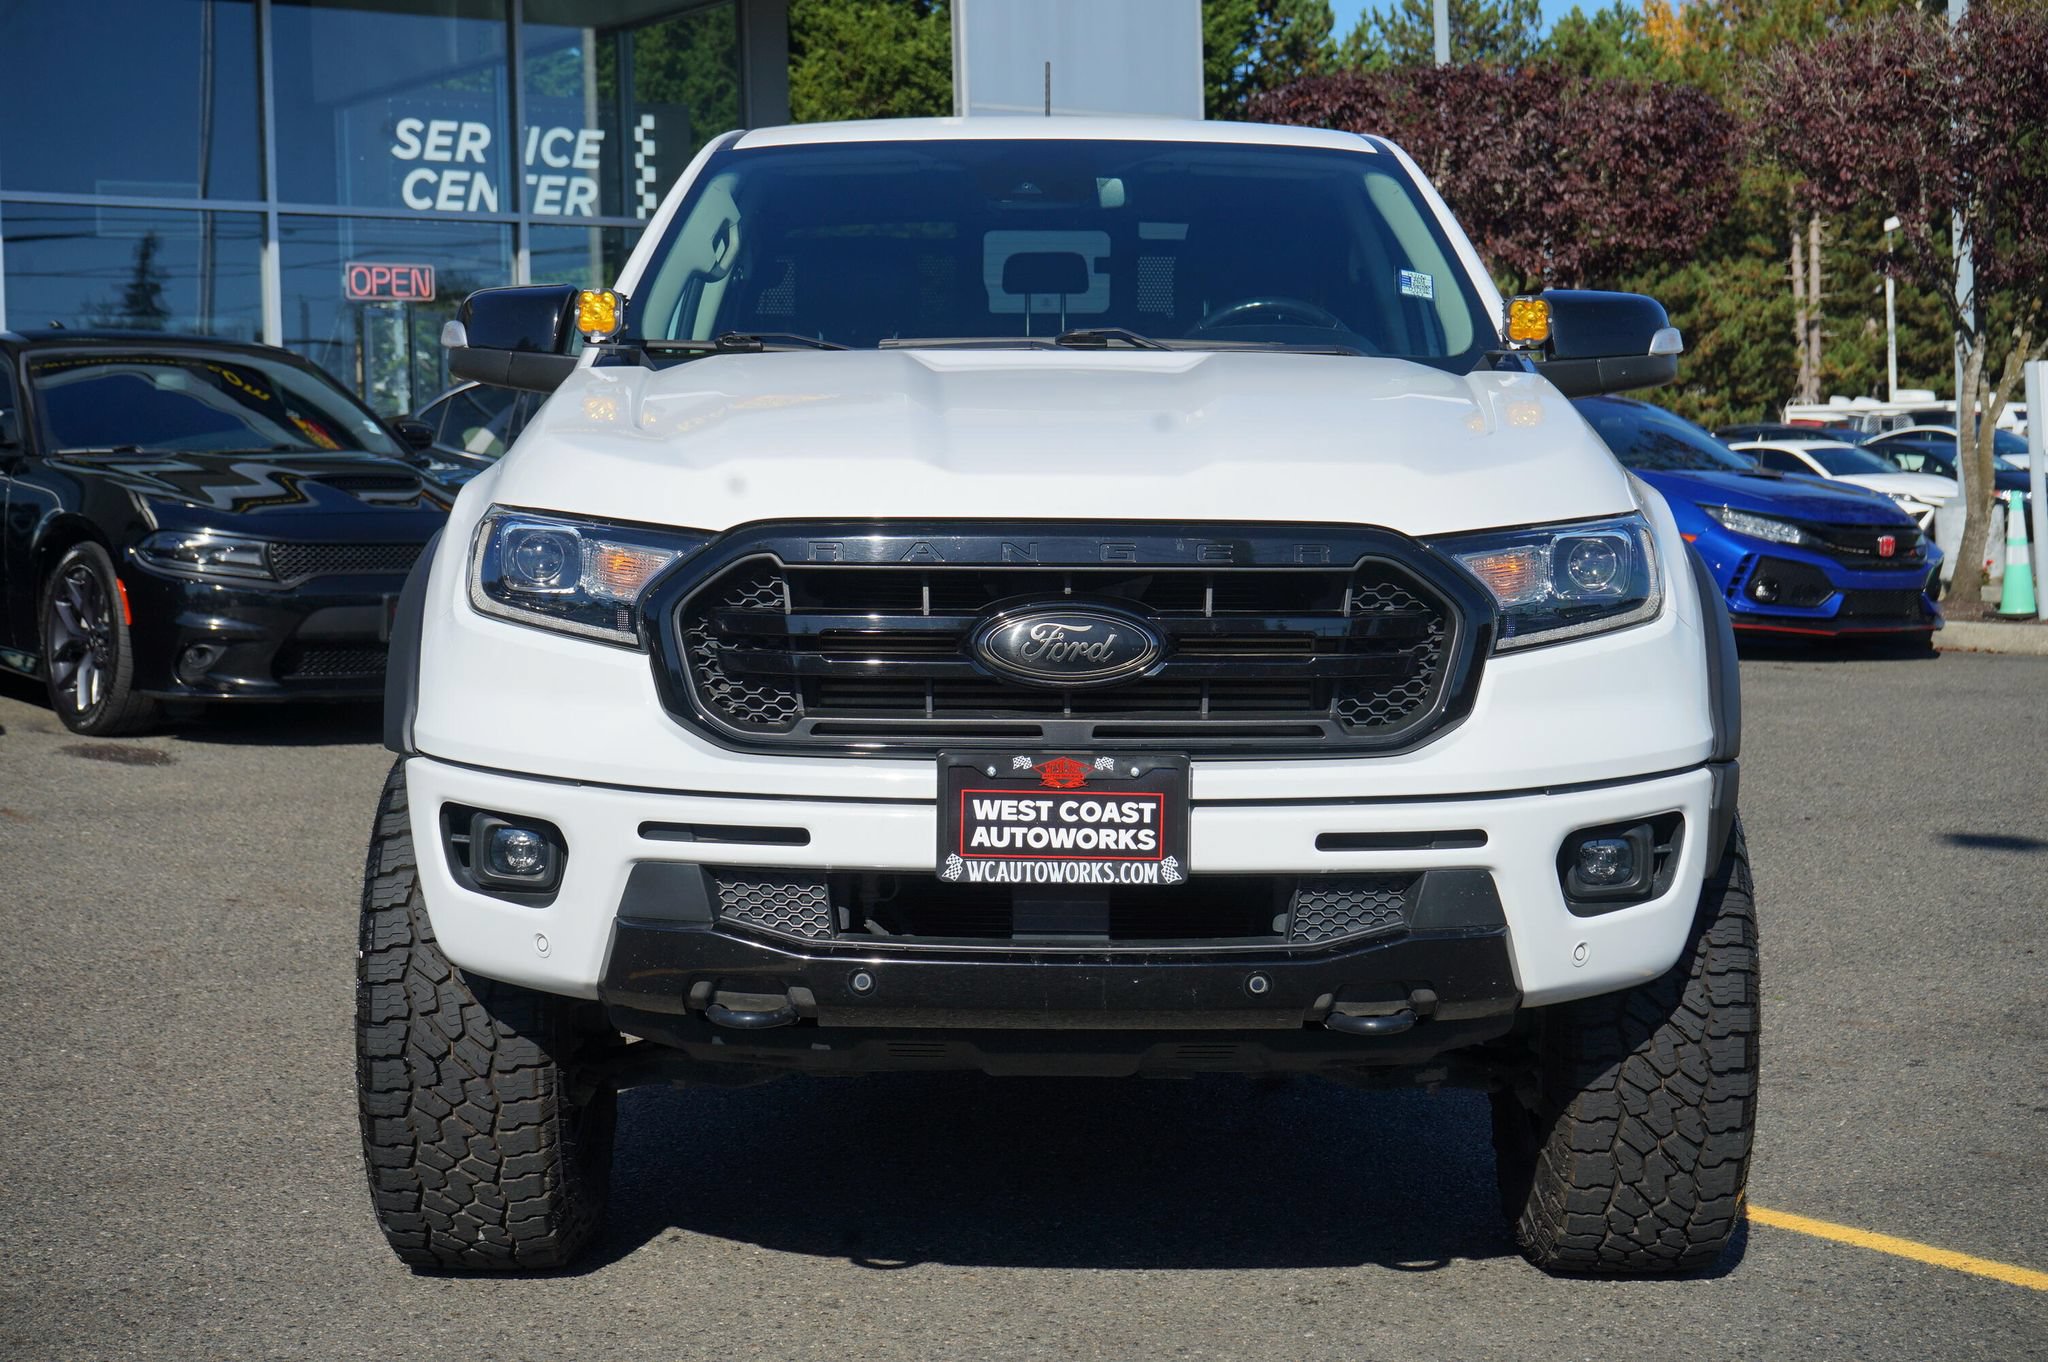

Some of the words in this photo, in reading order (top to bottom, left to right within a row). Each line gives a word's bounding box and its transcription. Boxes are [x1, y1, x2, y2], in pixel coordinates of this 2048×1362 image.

[391, 118, 605, 169] SERICE
[350, 266, 431, 297] OPEN
[808, 541, 1331, 563] RANGER
[1020, 622, 1118, 663] Ford
[972, 799, 1053, 822] WEST
[1059, 801, 1157, 824] COAST
[970, 826, 1157, 850] AUTOWORKS
[966, 860, 1159, 884] WCAUTOWORKS.COM
